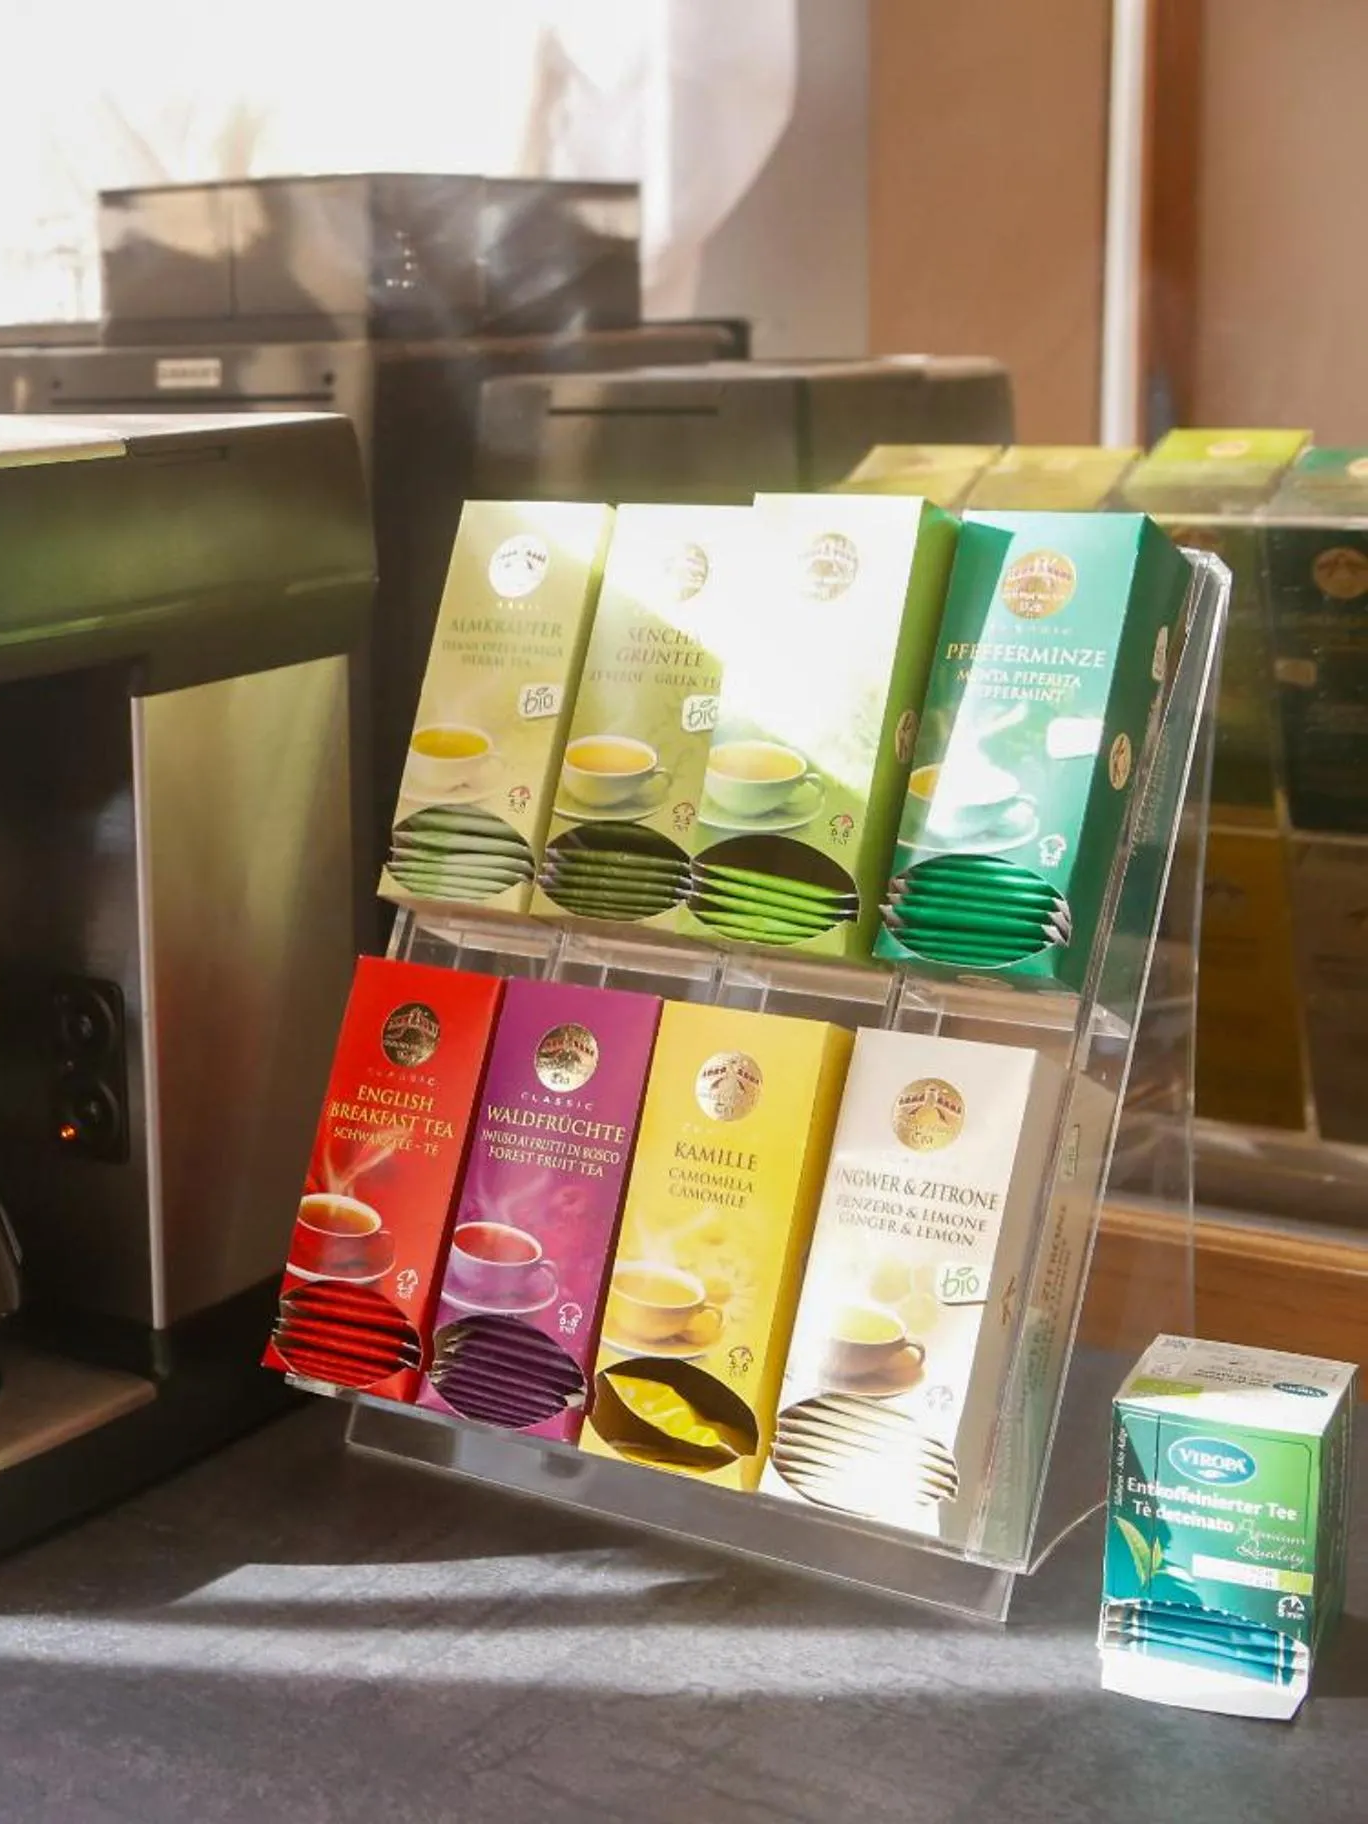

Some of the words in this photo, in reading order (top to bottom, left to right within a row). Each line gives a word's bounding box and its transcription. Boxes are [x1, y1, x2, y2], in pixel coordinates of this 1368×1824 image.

[946, 642, 1107, 668] PFEFFERMINZE
[524, 686, 554, 715] bio
[357, 1084, 435, 1112] ENGLISH
[520, 1091, 594, 1112] CLASSIC
[330, 1101, 419, 1132] BREAKFAST
[424, 1118, 453, 1139] TEA
[487, 1104, 627, 1144] WALDFRÜCHTE
[488, 1146, 535, 1164] FOREST
[537, 1153, 577, 1172] FRUIT
[579, 1162, 604, 1178] TEA
[582, 1146, 621, 1165] BOSCO
[674, 1141, 759, 1173] KAMILLE
[668, 1167, 753, 1194] CAMOMILLA
[835, 1167, 900, 1194] INGWER
[903, 1181, 917, 1197] &
[919, 1180, 1000, 1212] ZITRONE
[669, 1183, 746, 1209] CAMOMILE
[838, 1211, 898, 1234] GINGER
[900, 1223, 912, 1236] &
[916, 1224, 975, 1248] LEMON
[905, 1206, 918, 1220] &
[922, 1208, 989, 1233] LIMONE
[941, 1266, 980, 1297] bio
[1133, 1499, 1153, 1518] Tè
[1266, 1502, 1299, 1521] Tee
